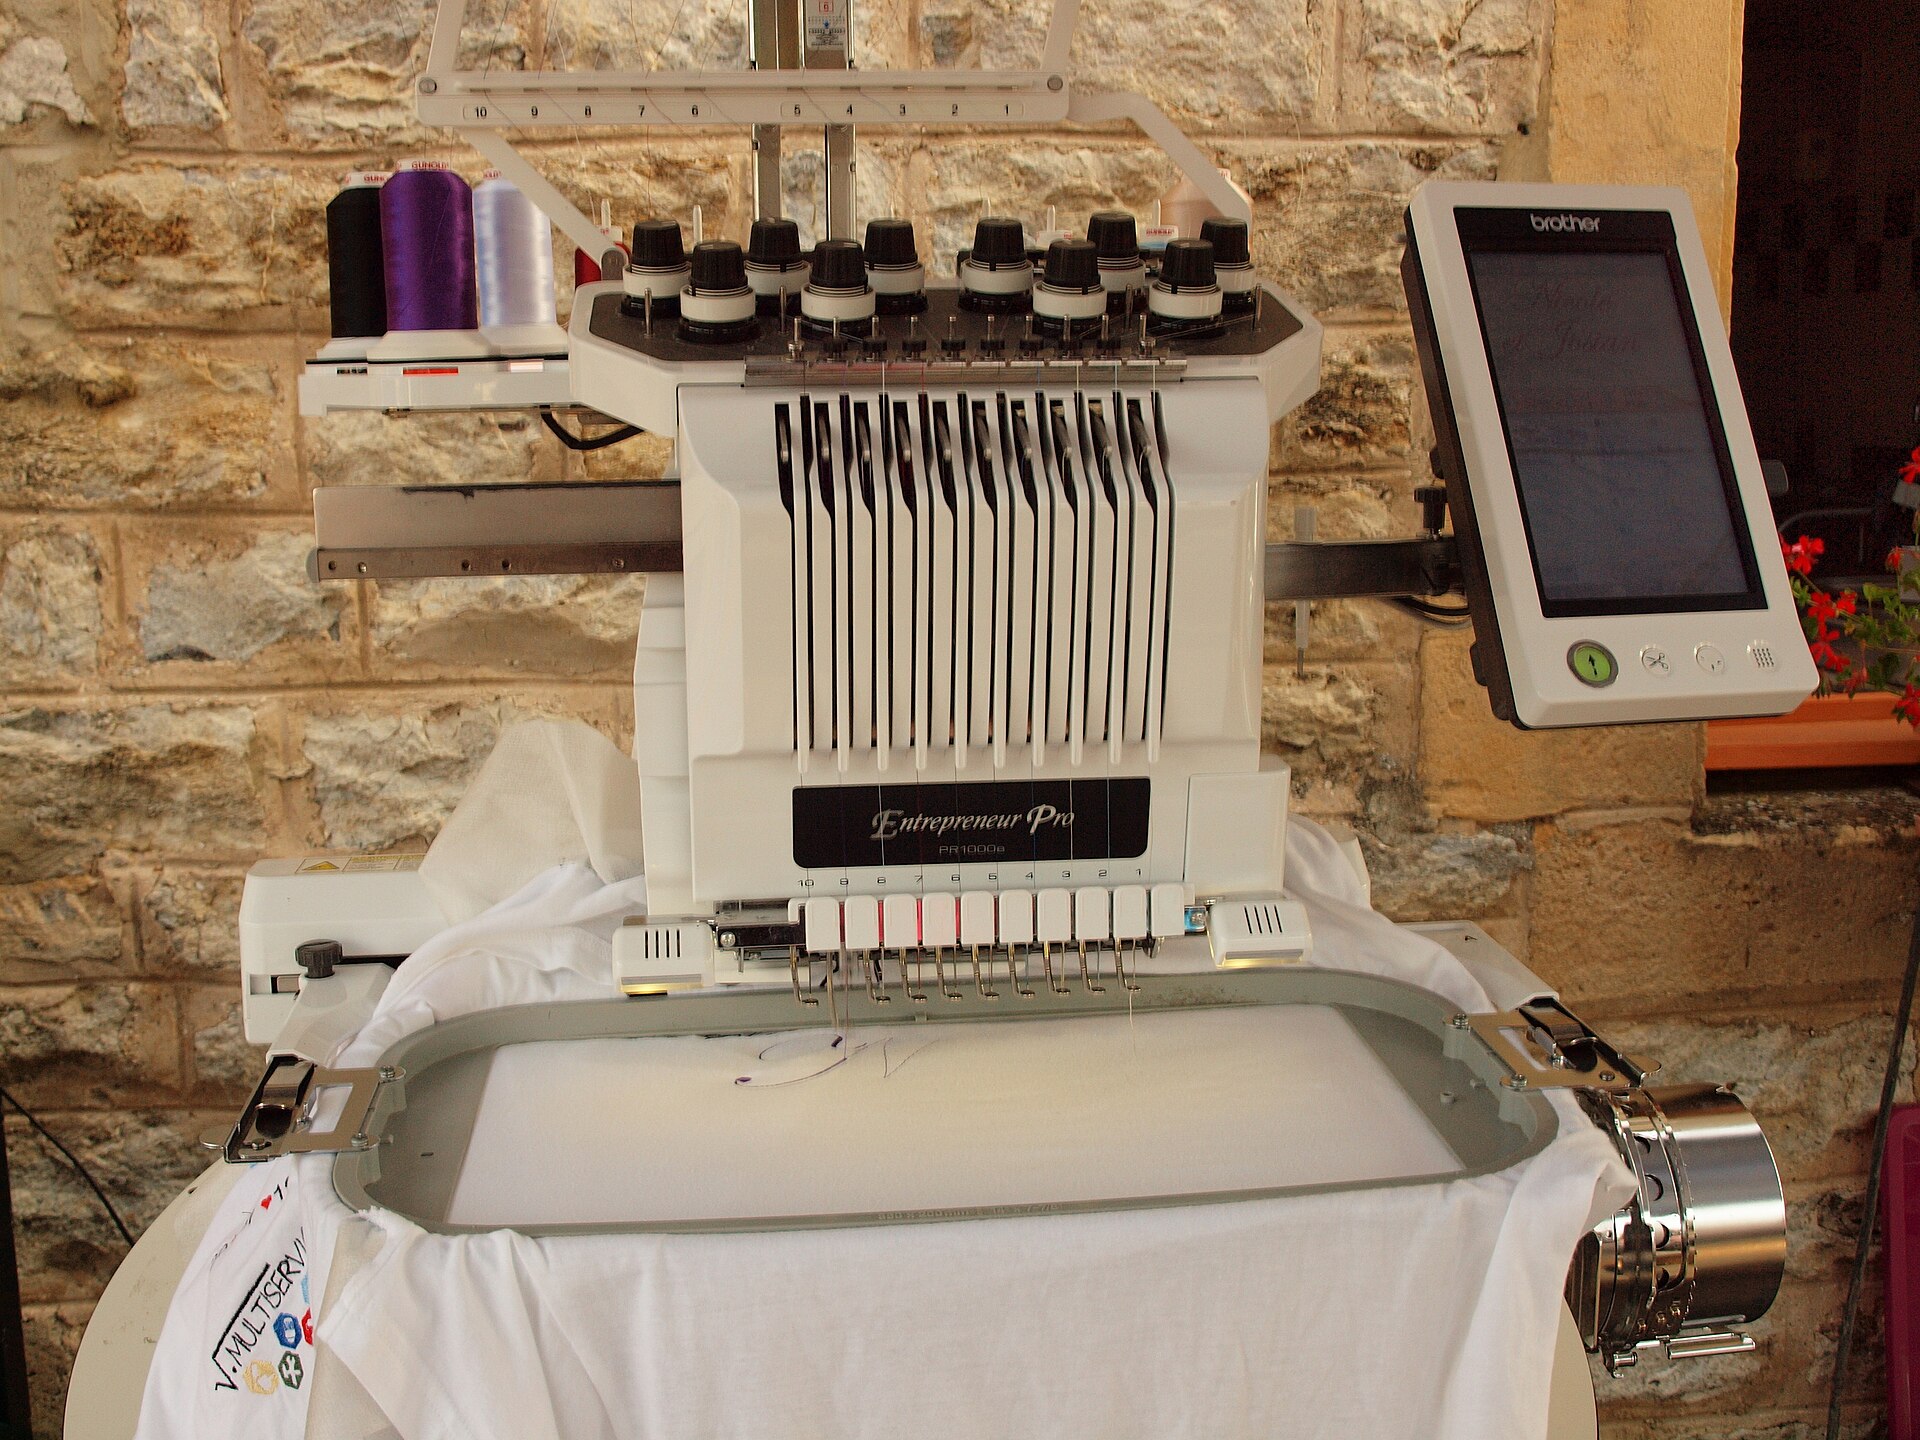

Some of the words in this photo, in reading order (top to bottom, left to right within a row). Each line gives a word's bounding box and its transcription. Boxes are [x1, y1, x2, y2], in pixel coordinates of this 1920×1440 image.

[474, 105, 488, 118] 10
[530, 105, 539, 118] 9
[584, 105, 592, 118] 8
[637, 105, 646, 118] 7
[691, 104, 699, 117] 6
[793, 104, 801, 117] 5
[846, 104, 854, 117] 4
[899, 104, 907, 117] 3
[951, 104, 959, 117] 2
[1004, 104, 1010, 117] 1
[1529, 213, 1601, 232] brother
[869, 808, 1023, 841] Entrepreneur
[1026, 804, 1075, 836] Pro
[938, 844, 1006, 855] PR1000e
[797, 878, 815, 887] 10
[839, 877, 849, 886] 9
[914, 874, 924, 883] 7
[988, 872, 998, 880] 5
[1025, 871, 1034, 879] 4
[1061, 870, 1071, 878] 3
[1098, 869, 1108, 877] 2
[1135, 868, 1142, 876] 1
